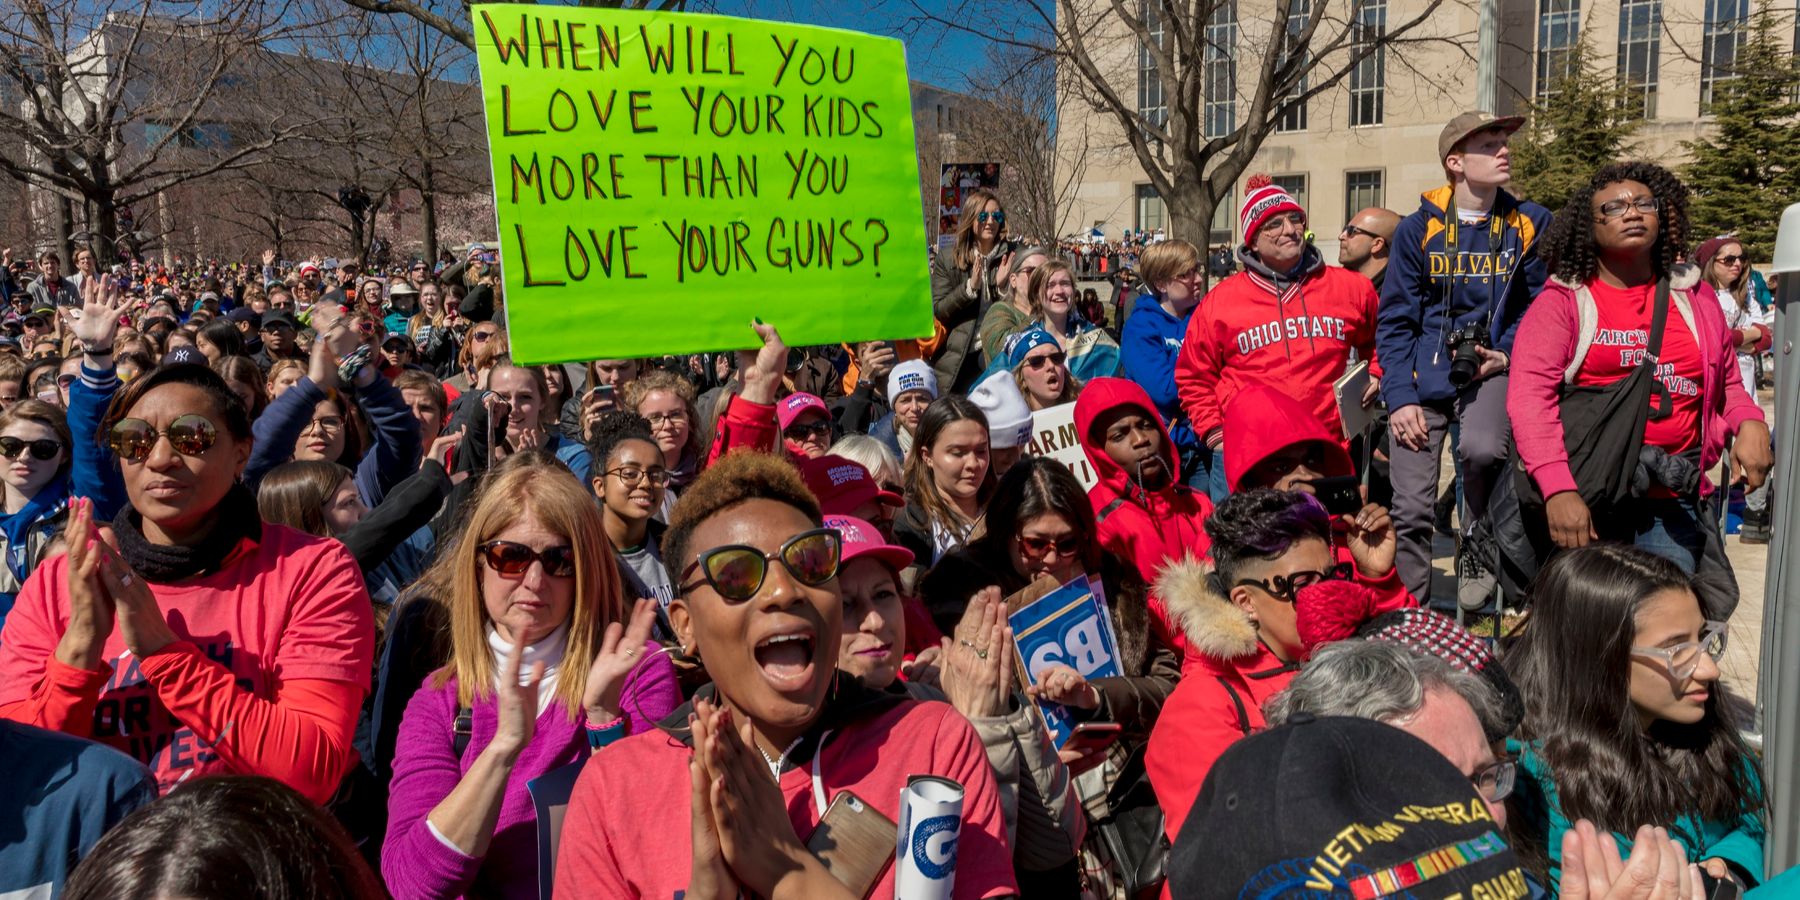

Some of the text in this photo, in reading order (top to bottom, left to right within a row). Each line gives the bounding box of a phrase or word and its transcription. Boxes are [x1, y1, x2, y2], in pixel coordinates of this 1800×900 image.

[480, 10, 854, 87] WHEN WILL YOU
[501, 84, 883, 138] LOVE YOUR KIDS
[511, 148, 848, 204] MORE THAN YOU
[515, 217, 889, 287] LOVE YOUR GUNS?
[1236, 316, 1346, 355] OHIO STATE
[1659, 375, 1698, 396] VES
[94, 695, 151, 737] OR
[130, 728, 219, 774] IVES
[1394, 798, 1492, 825] VERA
